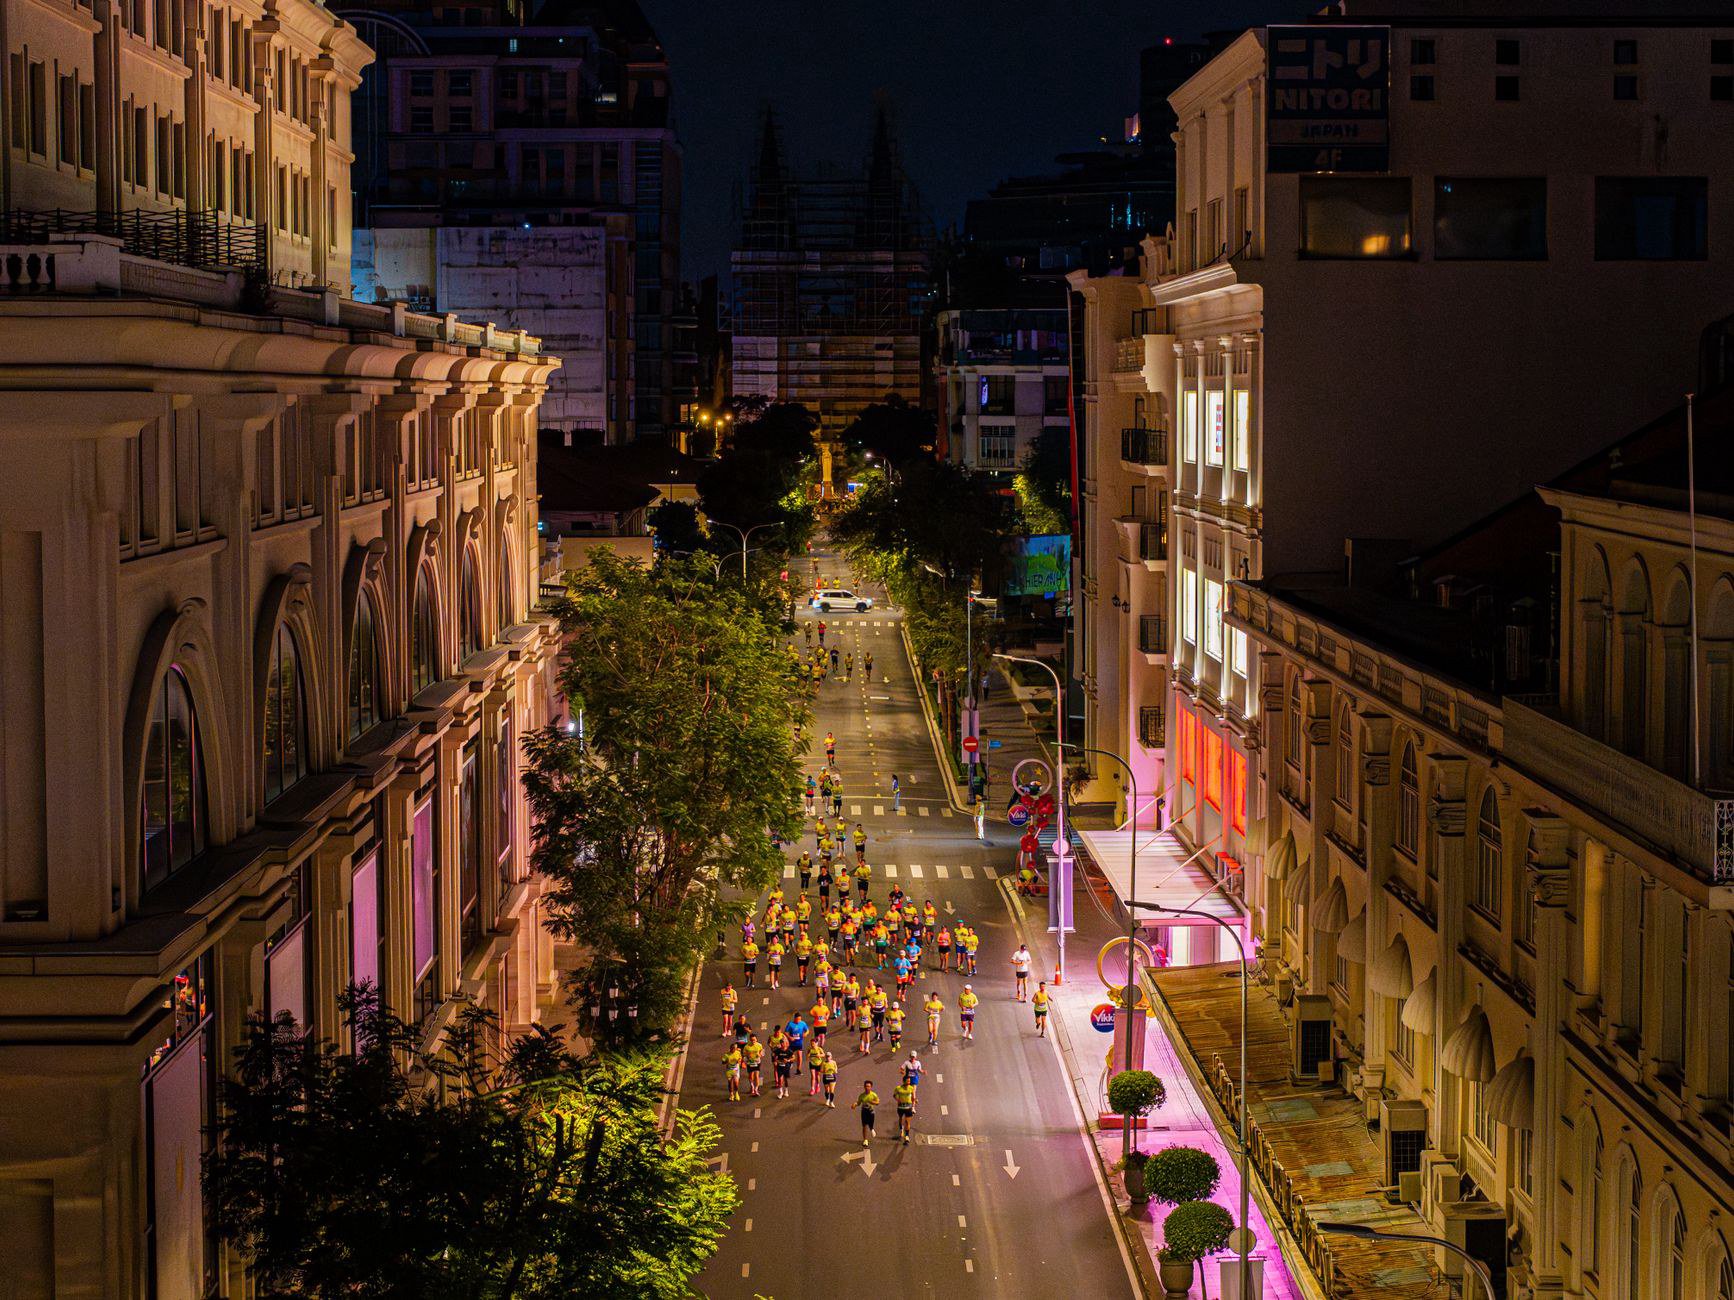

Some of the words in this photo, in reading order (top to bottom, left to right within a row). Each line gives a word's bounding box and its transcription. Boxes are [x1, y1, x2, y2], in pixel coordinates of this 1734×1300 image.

[1275, 38, 1382, 80] ニトリ
[1274, 88, 1382, 112] NITORI
[1303, 124, 1359, 138] JAPAN
[1313, 148, 1343, 167] 4F
